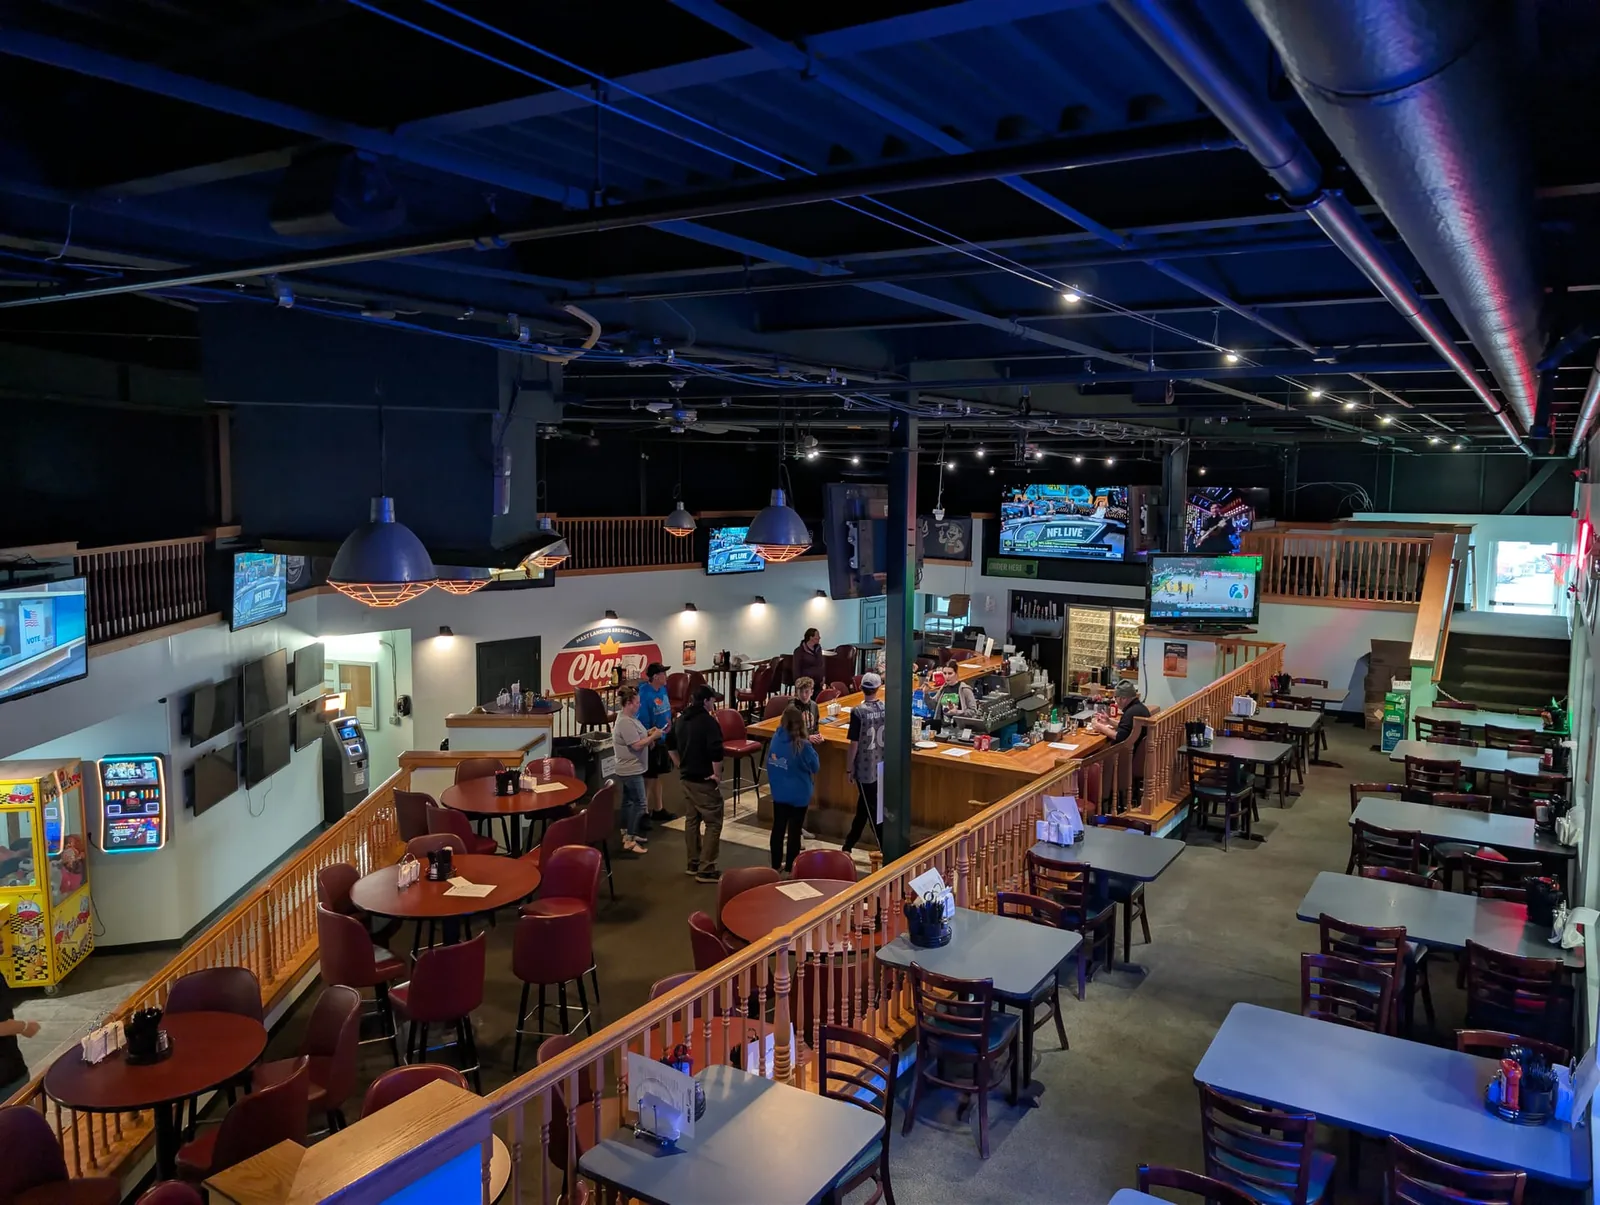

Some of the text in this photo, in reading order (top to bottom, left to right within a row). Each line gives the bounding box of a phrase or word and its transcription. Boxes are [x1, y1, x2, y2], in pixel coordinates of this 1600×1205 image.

[1046, 527, 1084, 538] NFL LIVE
[988, 562, 1022, 572] ORDER HERE
[26, 634, 41, 645] VOTE
[576, 633, 590, 644] MAST
[590, 627, 611, 637] LANDING
[612, 627, 632, 635] BREWING
